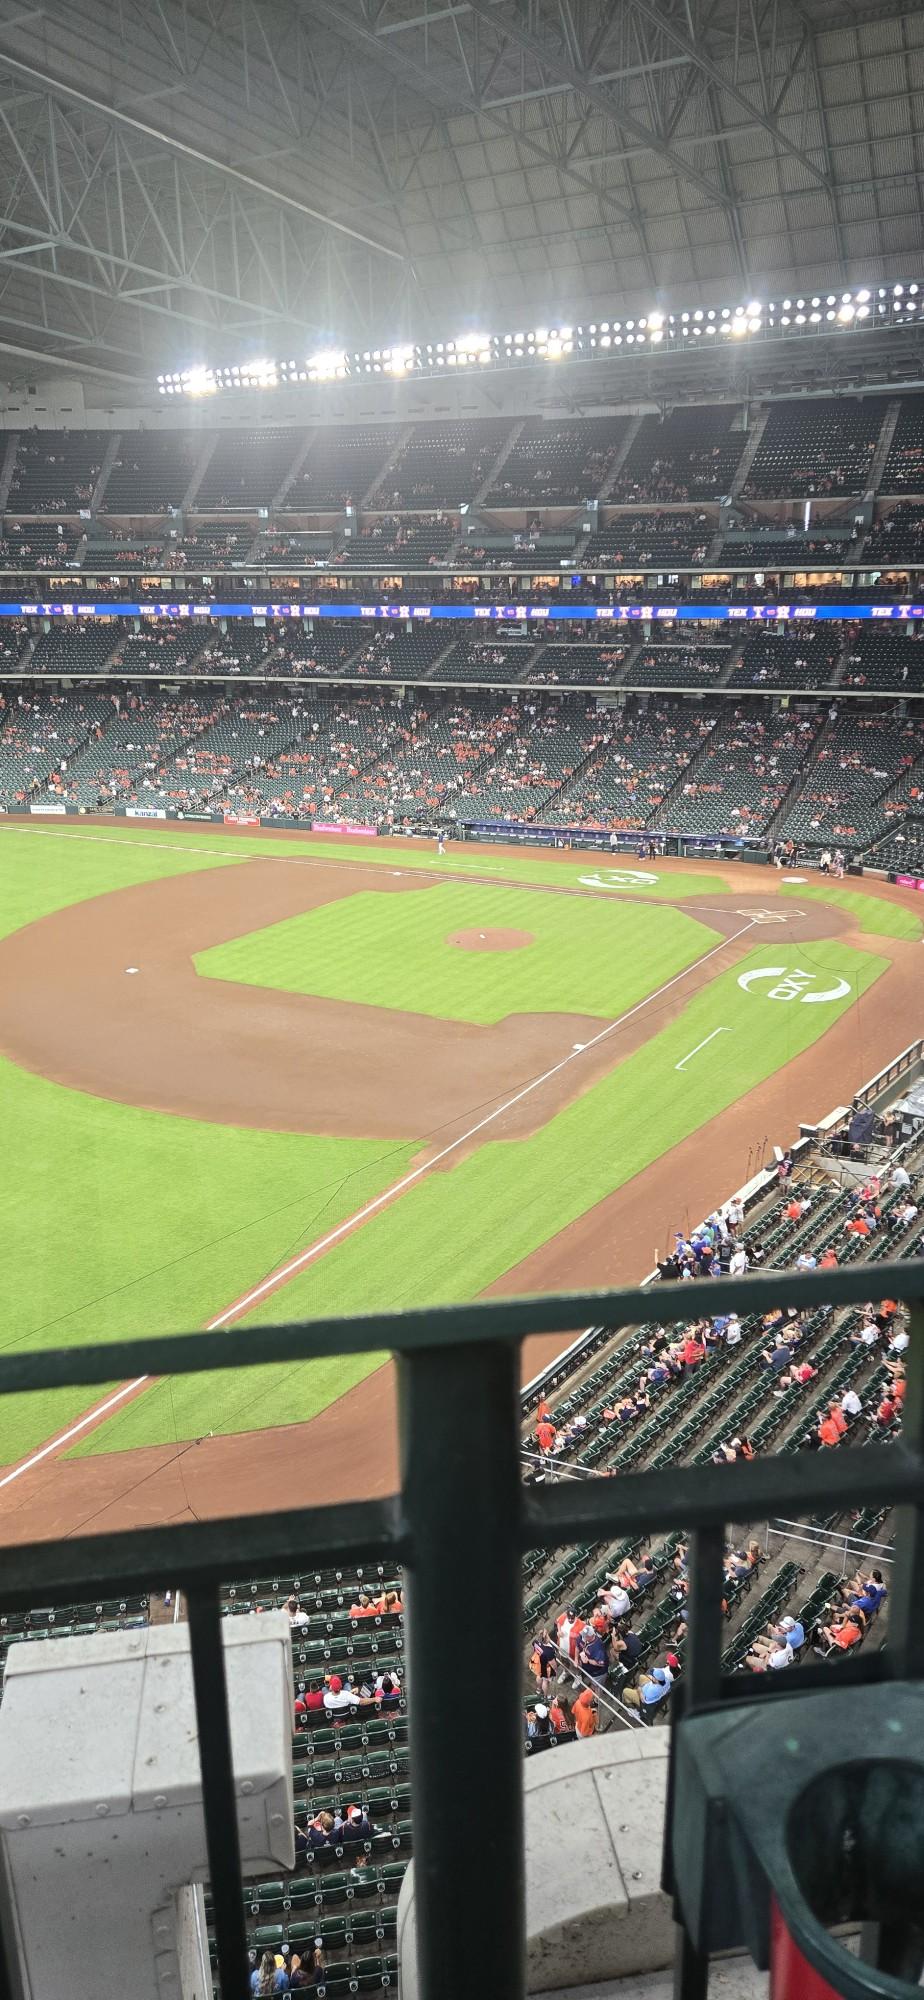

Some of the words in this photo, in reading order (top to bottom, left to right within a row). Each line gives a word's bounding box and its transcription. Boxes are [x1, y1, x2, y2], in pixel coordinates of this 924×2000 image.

[193, 606, 211, 614] HOU
[252, 606, 268, 614] TEX
[303, 606, 320, 615] HOU
[360, 607, 377, 616] TEX
[413, 607, 431, 616] HOU
[474, 608, 491, 616] TEX
[530, 608, 549, 616] HOU
[596, 608, 614, 616] TEX
[657, 608, 678, 617] HOU
[728, 608, 748, 616] TEX
[794, 608, 816, 617] HOU
[871, 607, 893, 616] TEX
[767, 968, 817, 1001] OXY
